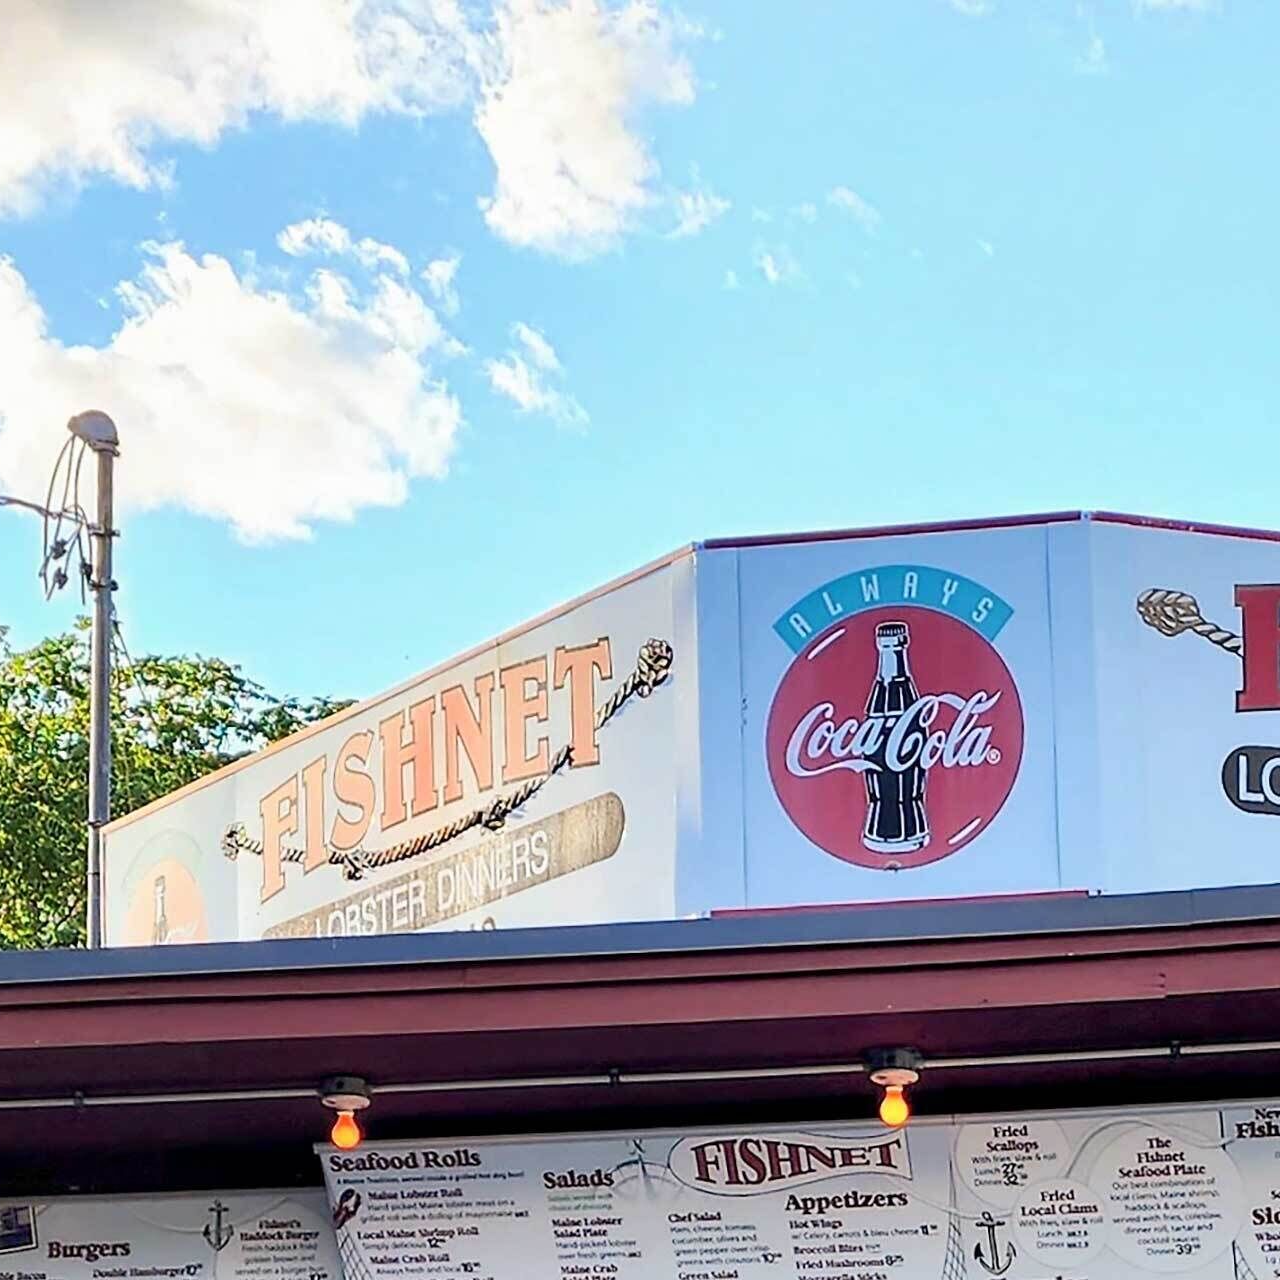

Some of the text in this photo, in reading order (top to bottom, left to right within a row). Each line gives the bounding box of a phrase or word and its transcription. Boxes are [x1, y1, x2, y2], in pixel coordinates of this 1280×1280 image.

[788, 571, 995, 638] ALWAYS
[260, 636, 611, 903] FISHNET
[436, 829, 550, 912] DINNERS
[992, 1125, 1028, 1139] Fried
[1236, 1121, 1280, 1139] Fish
[986, 1139, 1039, 1154] Scallops
[1146, 1137, 1172, 1149] The
[329, 1149, 482, 1173] Seafood Rolls
[690, 1137, 902, 1186] FISHNET
[1137, 1150, 1185, 1163] Fishnet
[542, 1168, 615, 1189] Salads
[1118, 1163, 1206, 1178] Seafood Plate
[784, 1190, 910, 1215] Appetizers
[1039, 1189, 1075, 1202] Fried
[1021, 1202, 1099, 1216] Local Clams
[47, 1241, 131, 1262] Burgers
